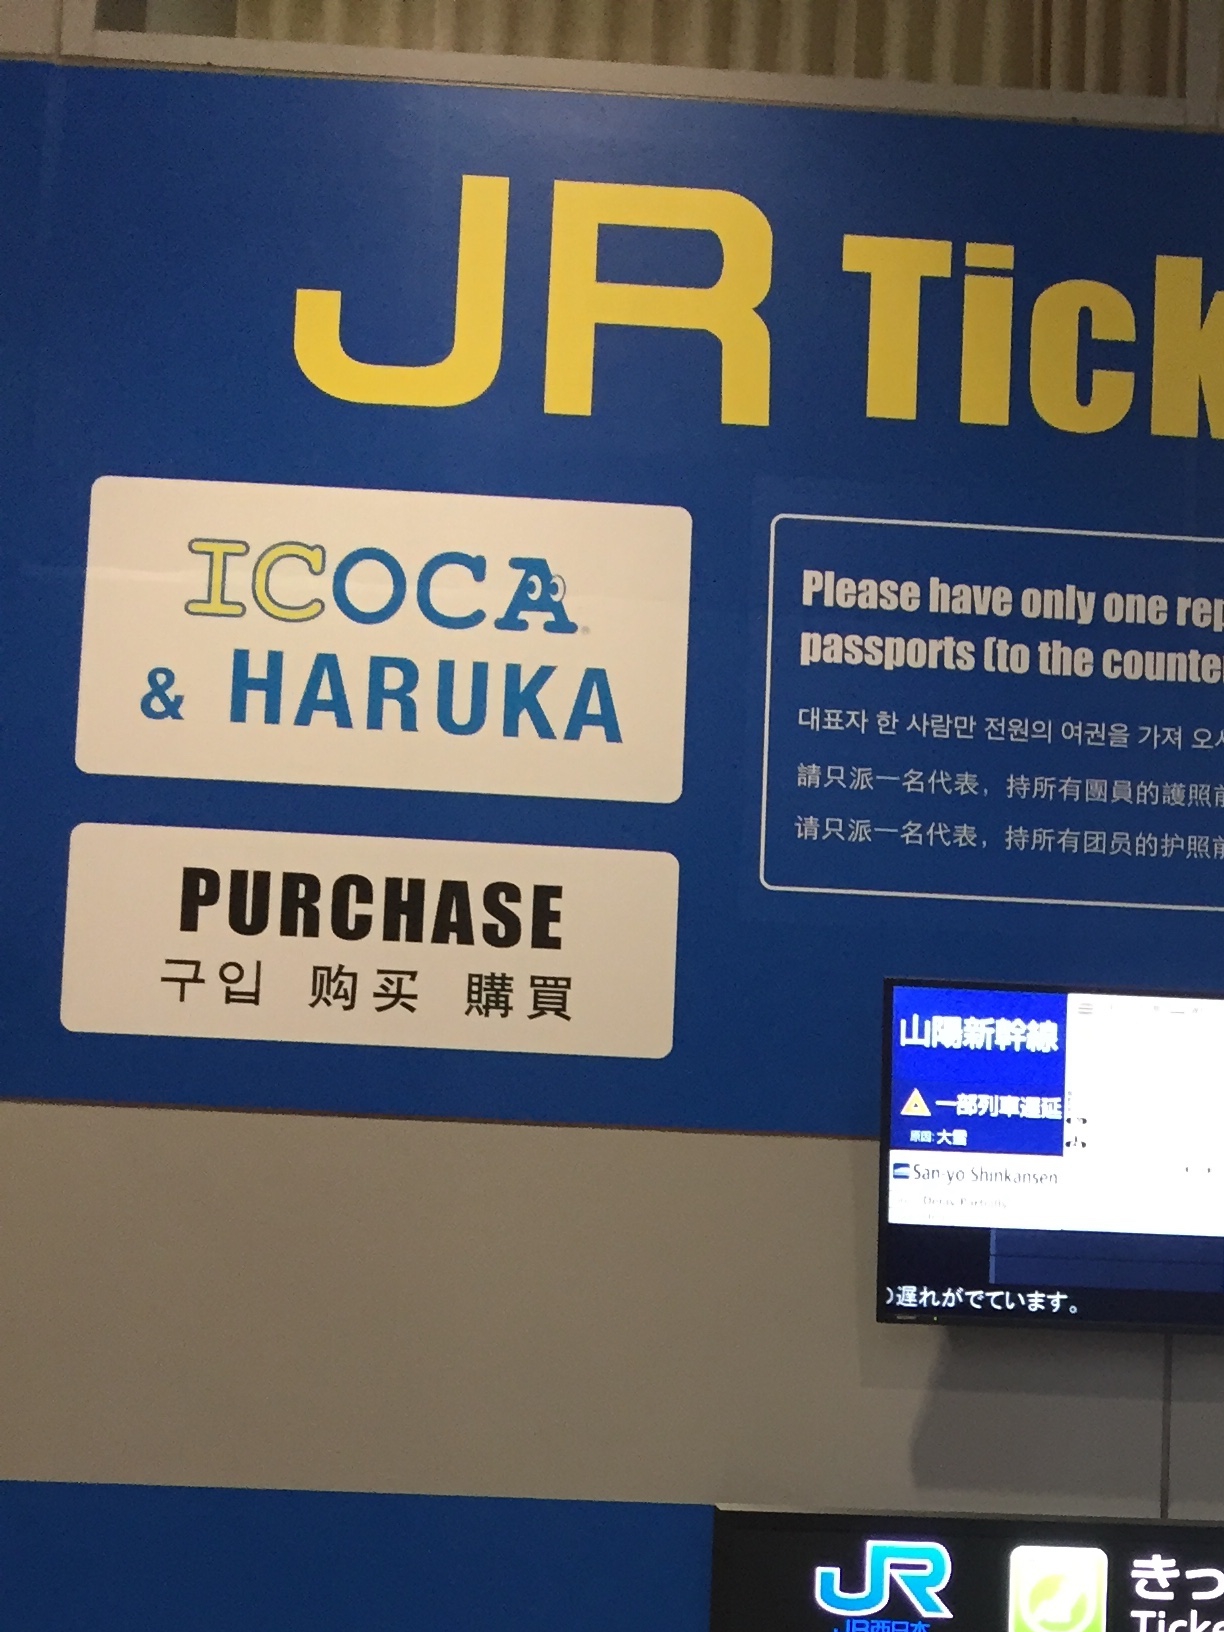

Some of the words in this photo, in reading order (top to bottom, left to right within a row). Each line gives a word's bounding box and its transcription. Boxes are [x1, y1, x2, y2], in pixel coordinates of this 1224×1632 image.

[293, 174, 773, 427] JR
[184, 537, 580, 636] ICOCA
[802, 569, 921, 612] Please
[930, 577, 1012, 617] have
[1021, 584, 1096, 627] only
[1104, 593, 1168, 626] one
[800, 629, 975, 673] passports
[982, 638, 1030, 675] (to
[1039, 640, 1094, 678] the
[140, 666, 185, 721] &
[229, 648, 624, 744] HARUKA
[798, 706, 869, 735] 대표자
[876, 709, 899, 735] 한
[906, 711, 977, 740] 사람만
[984, 715, 1054, 744] 전원의
[1061, 719, 1129, 749] 여권을
[1138, 724, 1183, 750] 가져
[180, 867, 564, 949] PURCHASE
[160, 958, 262, 1007] 구입
[310, 962, 421, 1013] 购买
[465, 971, 574, 1022] 購買
[815, 1540, 954, 1618] JR
